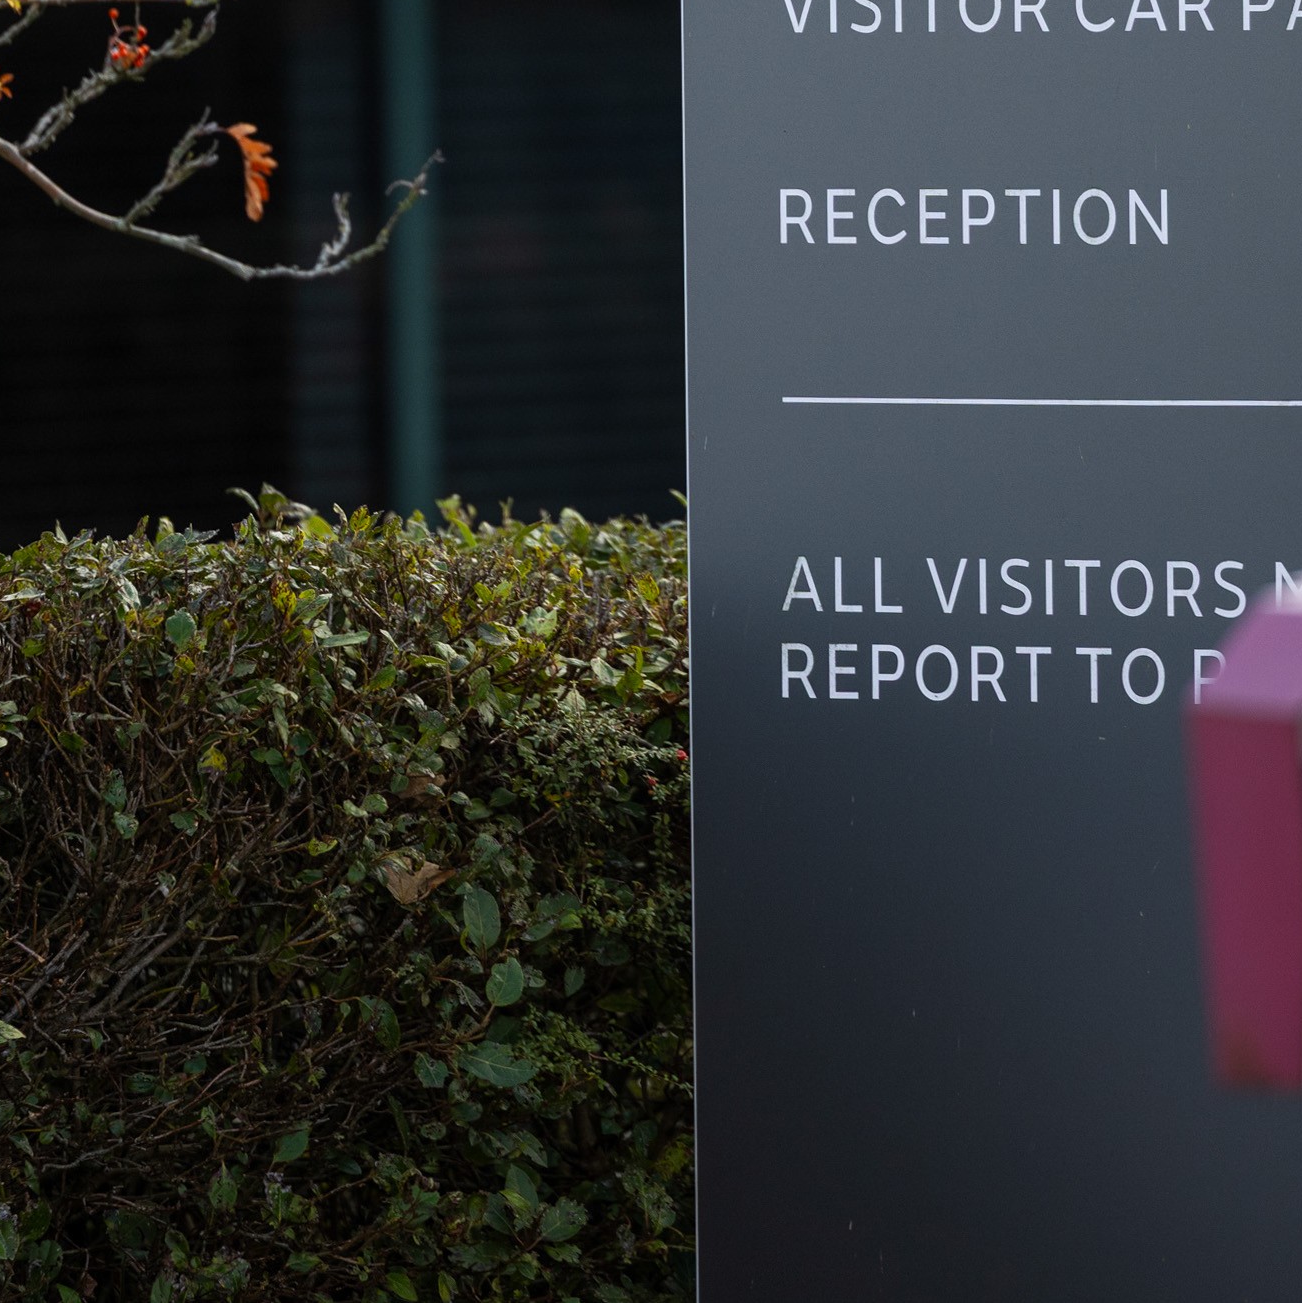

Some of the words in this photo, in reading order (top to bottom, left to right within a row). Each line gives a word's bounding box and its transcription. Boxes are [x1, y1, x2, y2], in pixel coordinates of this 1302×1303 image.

[779, 188, 1169, 246] RECEPTION
[782, 556, 903, 614] ALL
[926, 557, 1247, 619] VISITORS
[781, 642, 1052, 703] REPORT
[1075, 647, 1166, 705] TO
